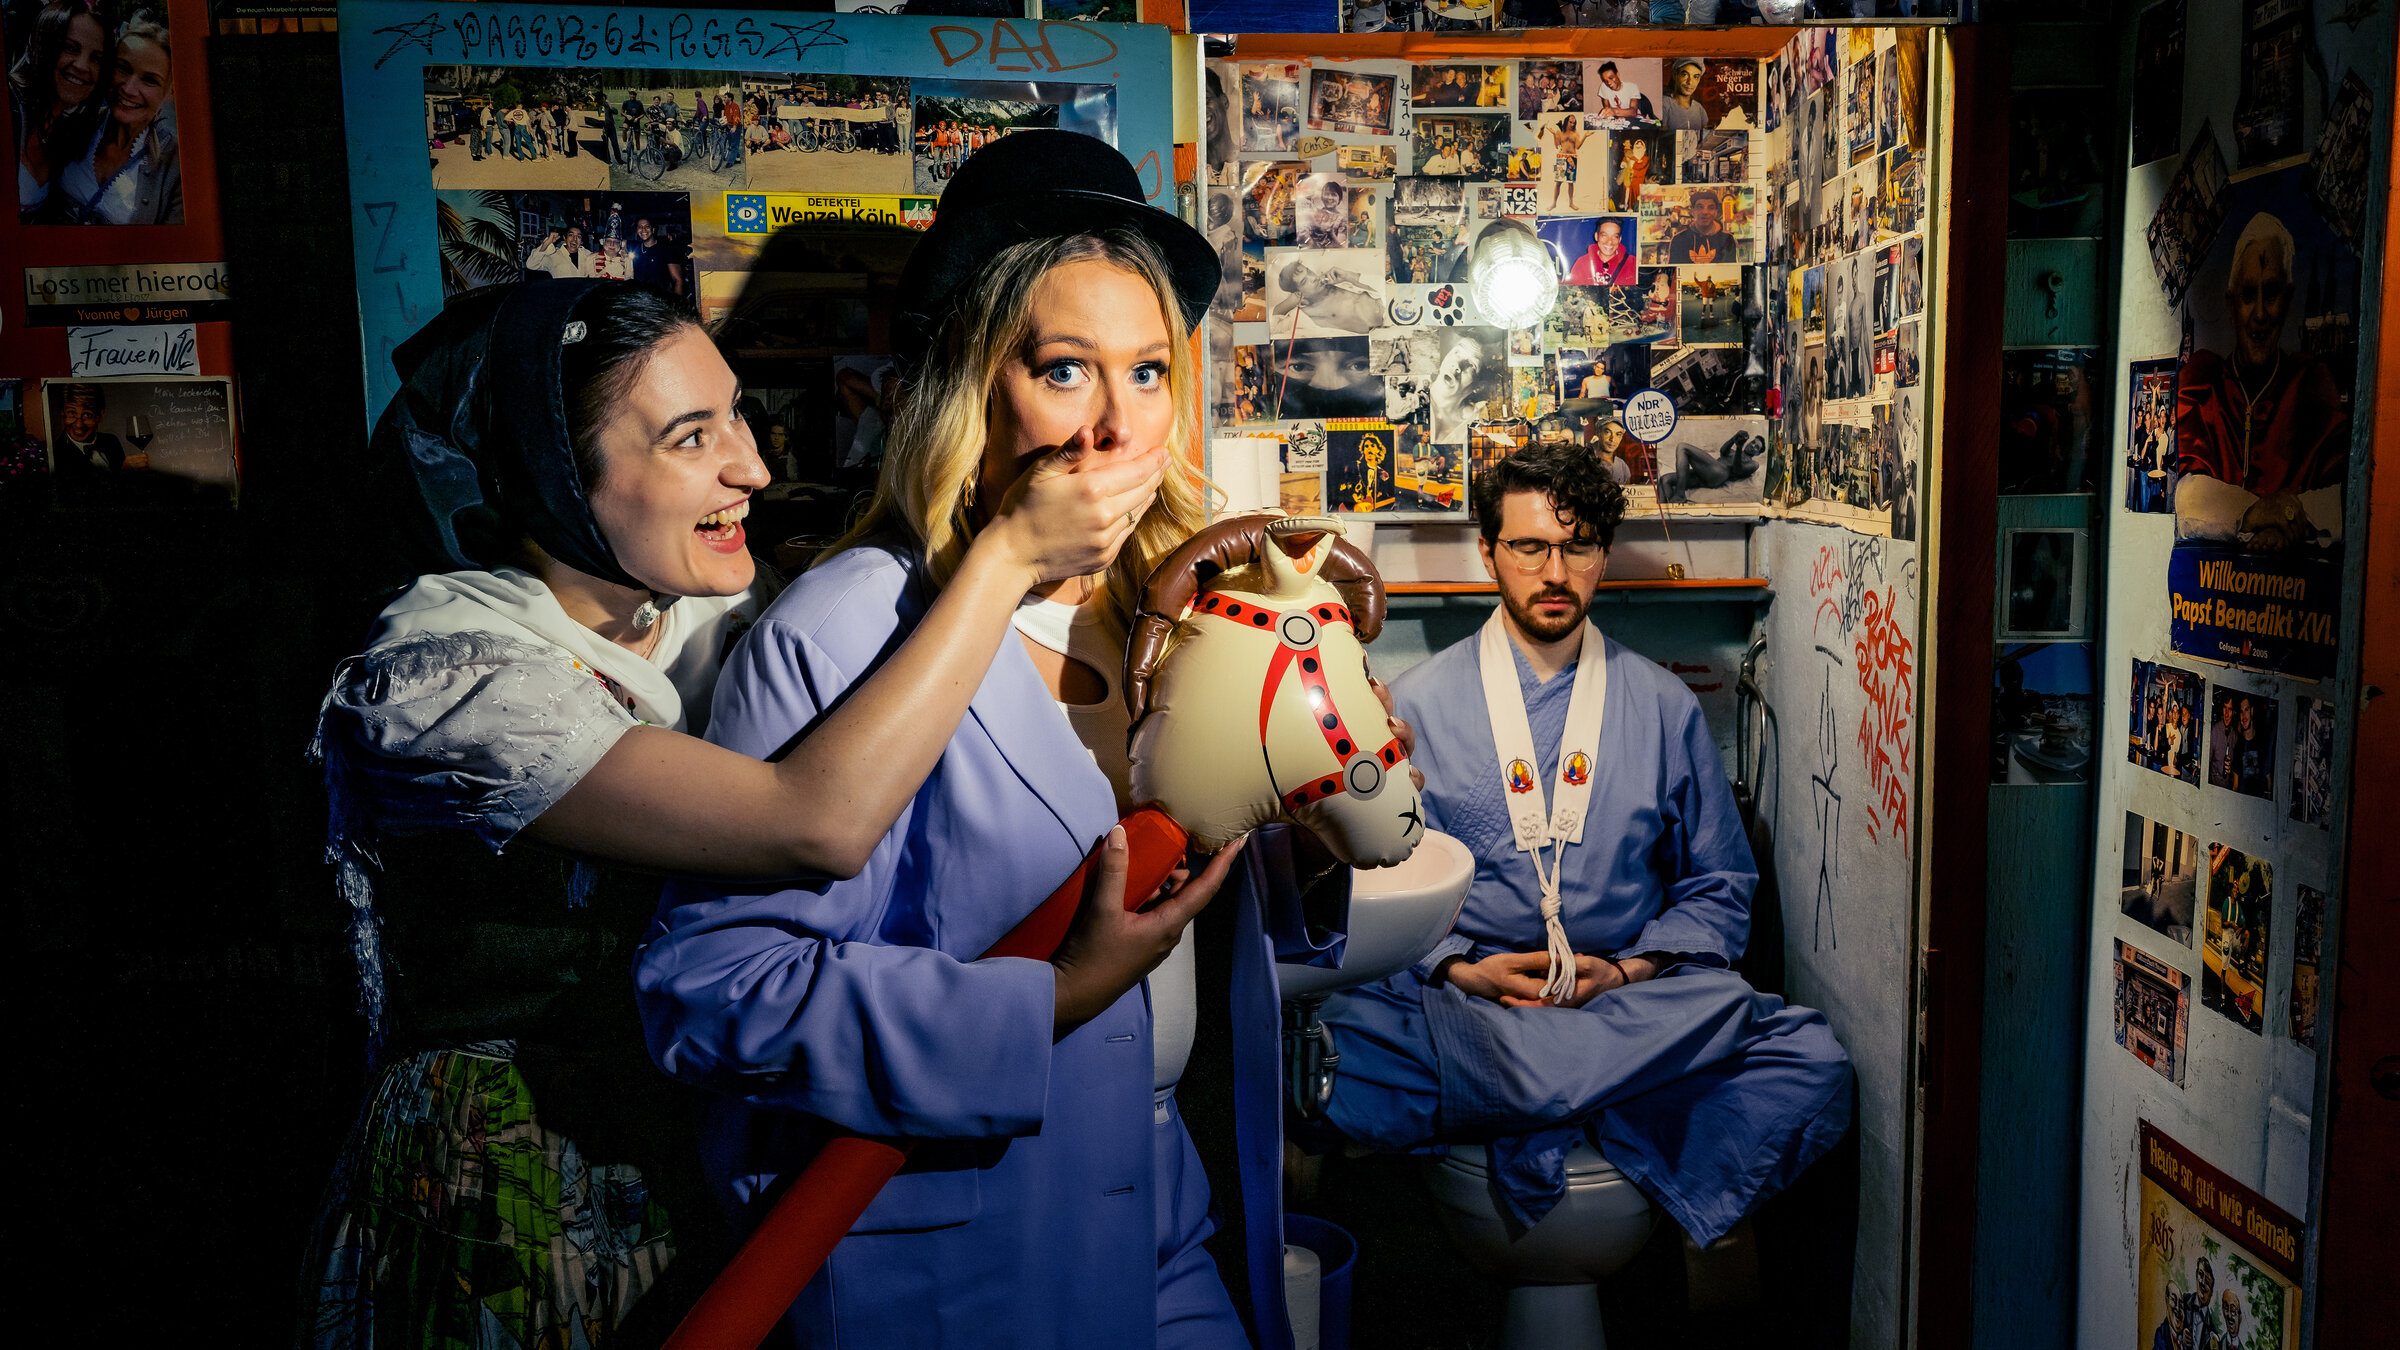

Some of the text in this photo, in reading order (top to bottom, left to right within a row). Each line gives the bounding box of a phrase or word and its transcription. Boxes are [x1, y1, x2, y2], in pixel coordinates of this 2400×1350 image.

[1716, 74, 1742, 85] Neger
[1726, 83, 1754, 92] NOBI
[808, 197, 861, 208] DETEKTEI
[1504, 188, 1537, 201] FCK
[744, 209, 752, 218] D
[772, 206, 897, 226] Wenzel Köln
[1504, 202, 1537, 215] NZS
[29, 274, 80, 295] Loss
[87, 274, 130, 294] mer
[1434, 288, 1454, 307] taz
[77, 306, 189, 321] Yvonne Jürgen
[80, 328, 195, 372] Frauen WC
[1628, 411, 1673, 431] ULTRAS
[2199, 560, 2306, 601] Willkommen
[2173, 592, 2337, 647] Papst Benedikt XVI.
[2218, 640, 2270, 660] Cologne 2005
[2150, 1136, 2296, 1263] Heute so gut wie damals
